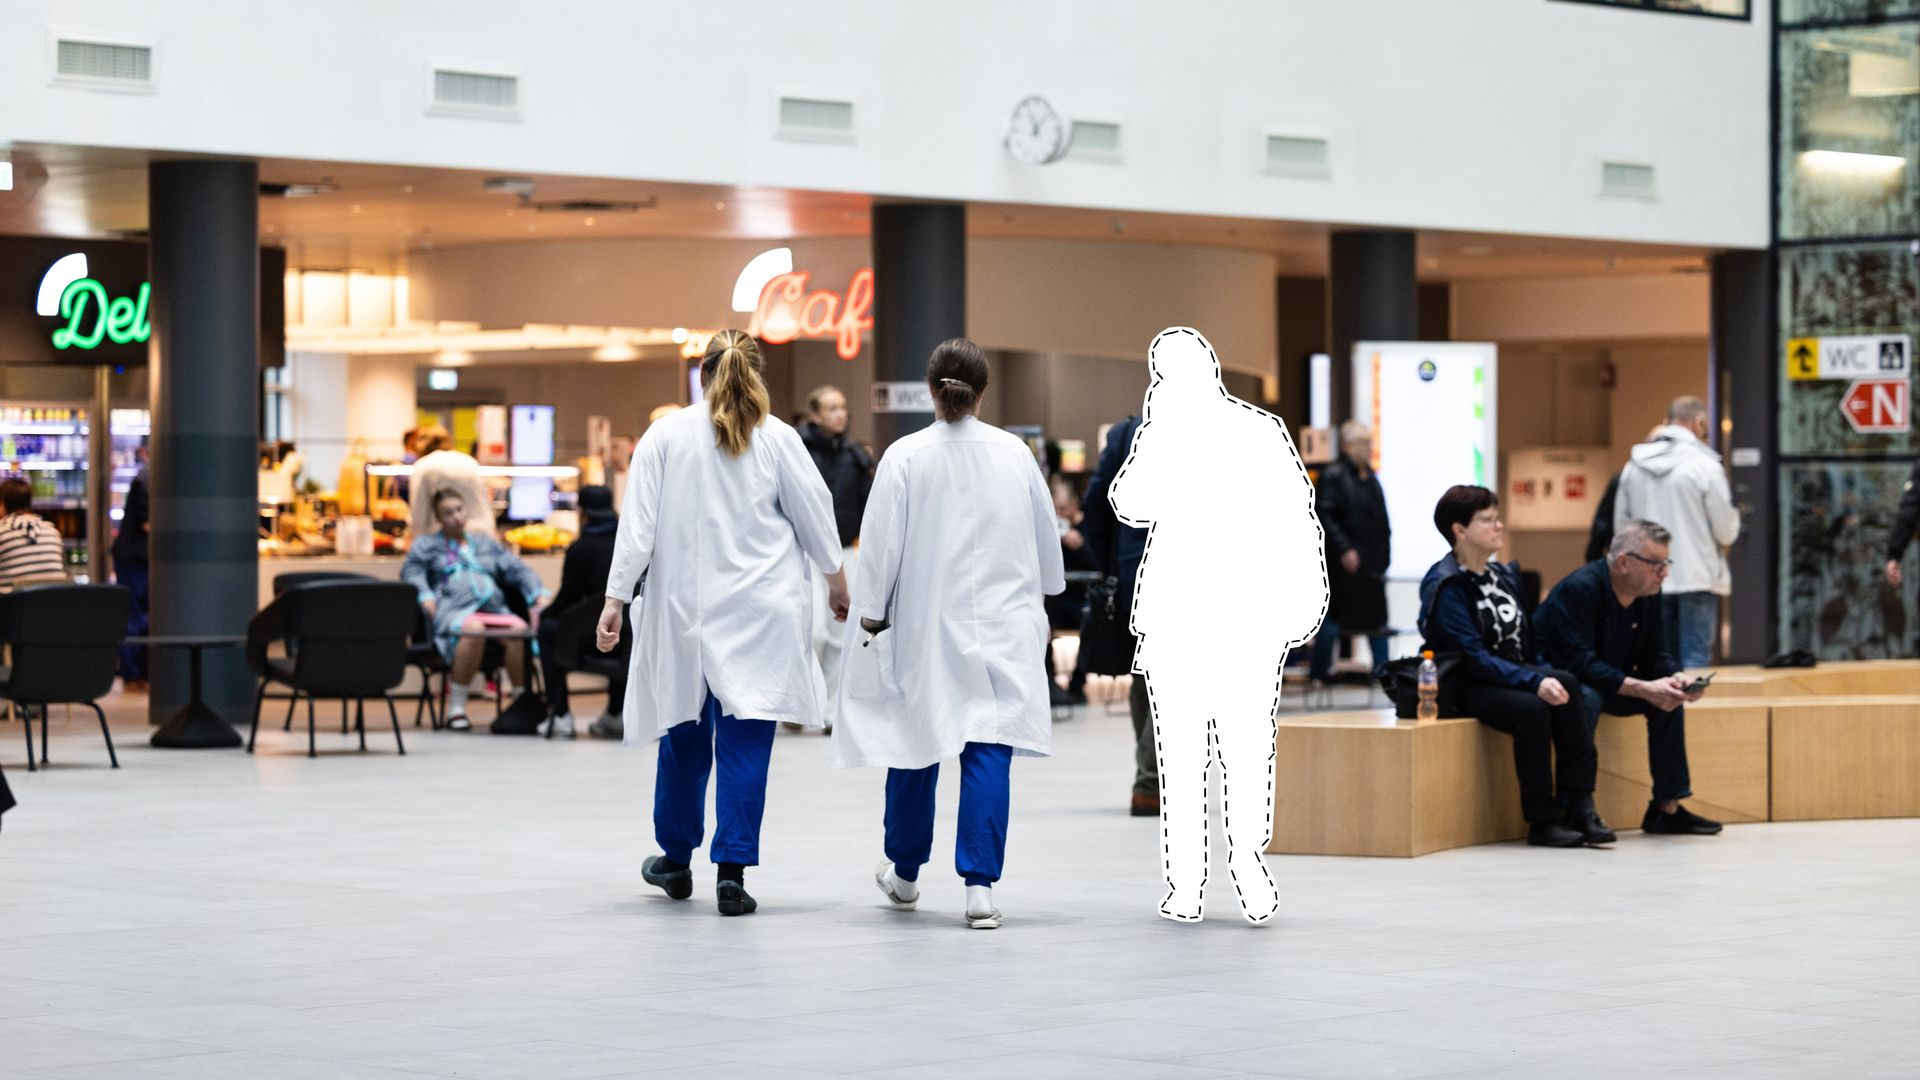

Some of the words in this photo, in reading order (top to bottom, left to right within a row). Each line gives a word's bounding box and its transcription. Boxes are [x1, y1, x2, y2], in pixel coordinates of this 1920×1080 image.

[52, 277, 150, 350] Del
[753, 267, 874, 360] Caf
[1826, 344, 1868, 370] WC
[895, 387, 929, 405] WC
[1872, 383, 1903, 425] N
